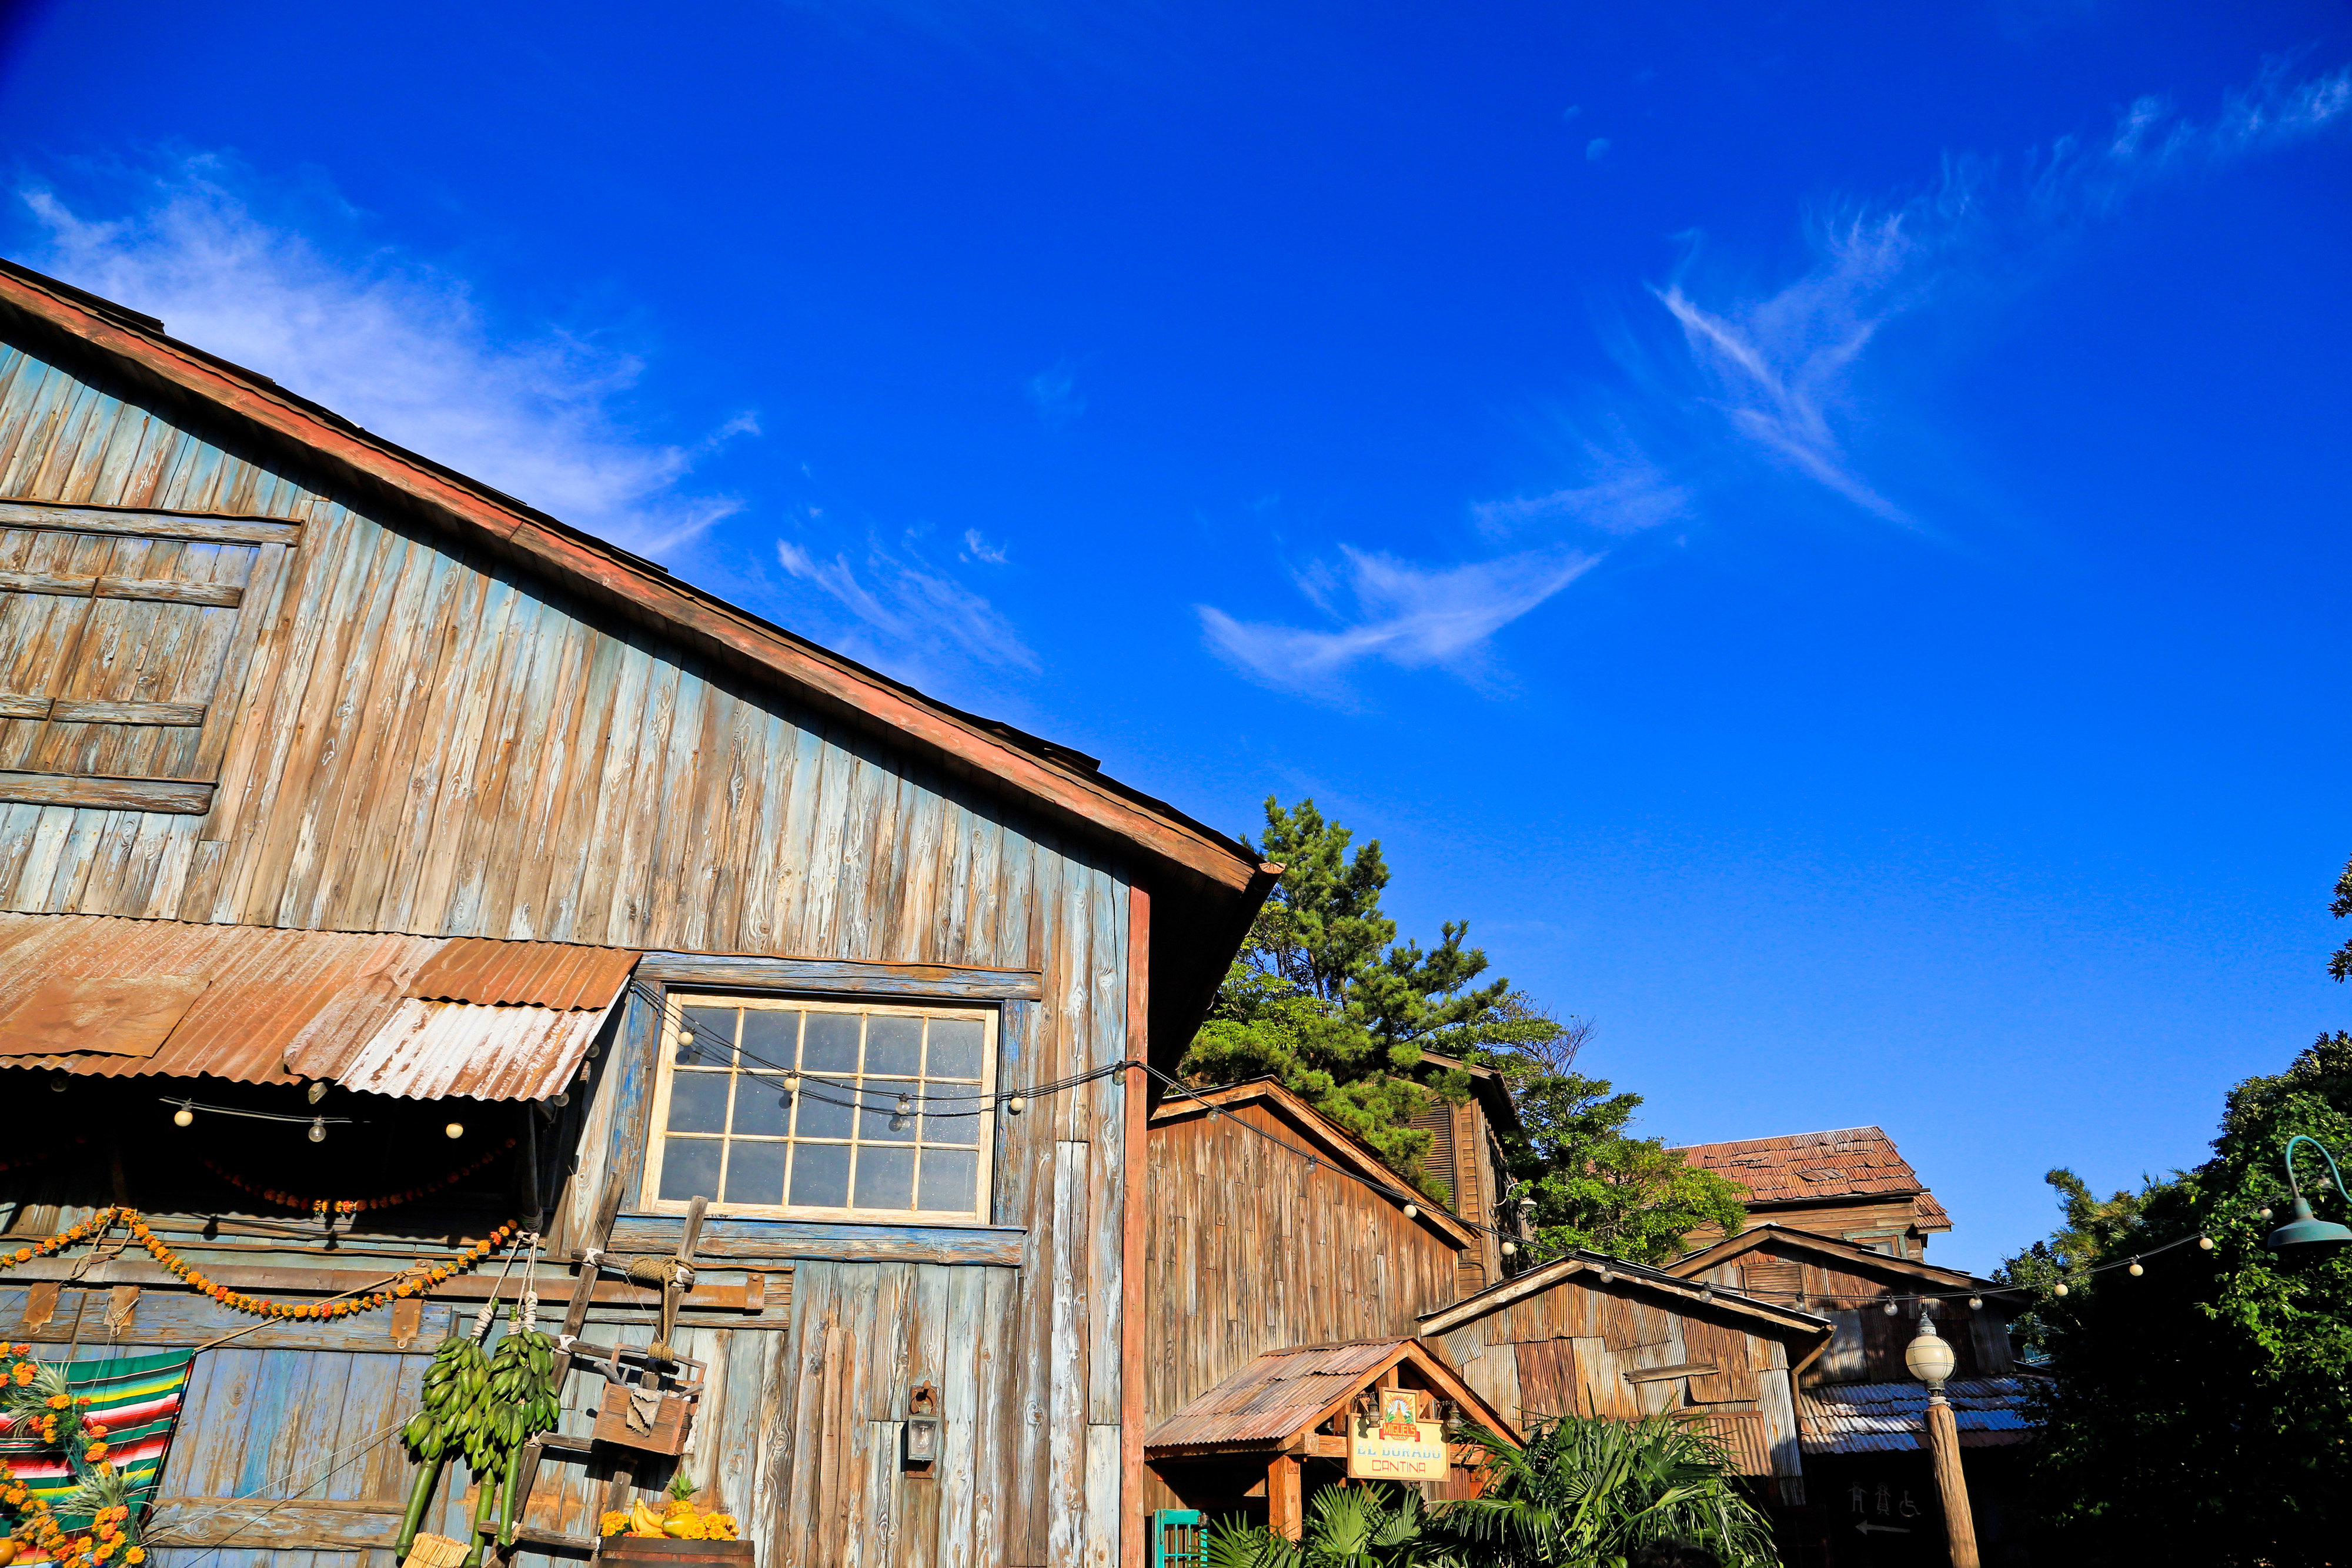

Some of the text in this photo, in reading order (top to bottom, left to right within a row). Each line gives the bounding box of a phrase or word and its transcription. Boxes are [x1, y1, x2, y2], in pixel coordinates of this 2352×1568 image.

[1384, 1423, 1415, 1436] MIGUEL'S
[1357, 1440, 1441, 1459] EL DORADO
[1372, 1460, 1426, 1474] CANTINA
